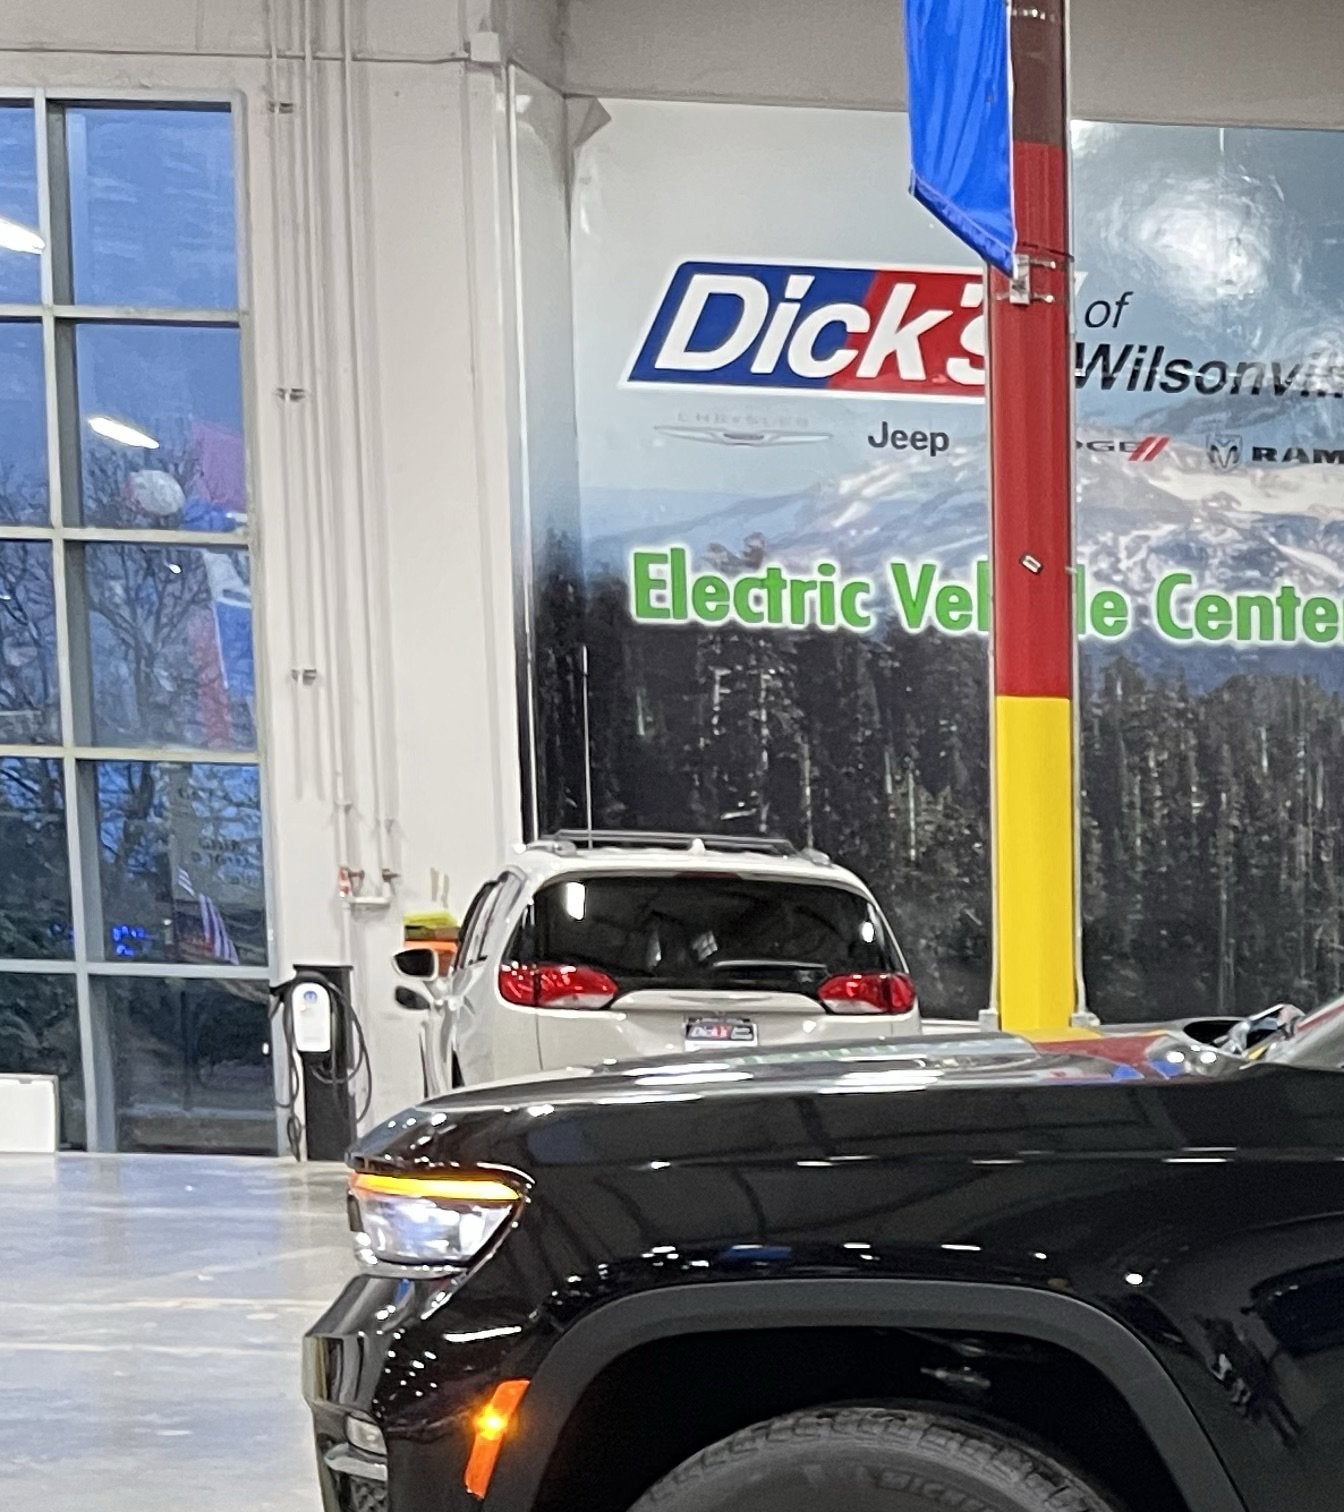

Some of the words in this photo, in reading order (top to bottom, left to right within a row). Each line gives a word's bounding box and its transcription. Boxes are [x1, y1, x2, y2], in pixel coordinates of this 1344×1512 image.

[1084, 291, 1134, 328] of
[867, 420, 950, 456] Jeep
[634, 547, 871, 628] Electric
